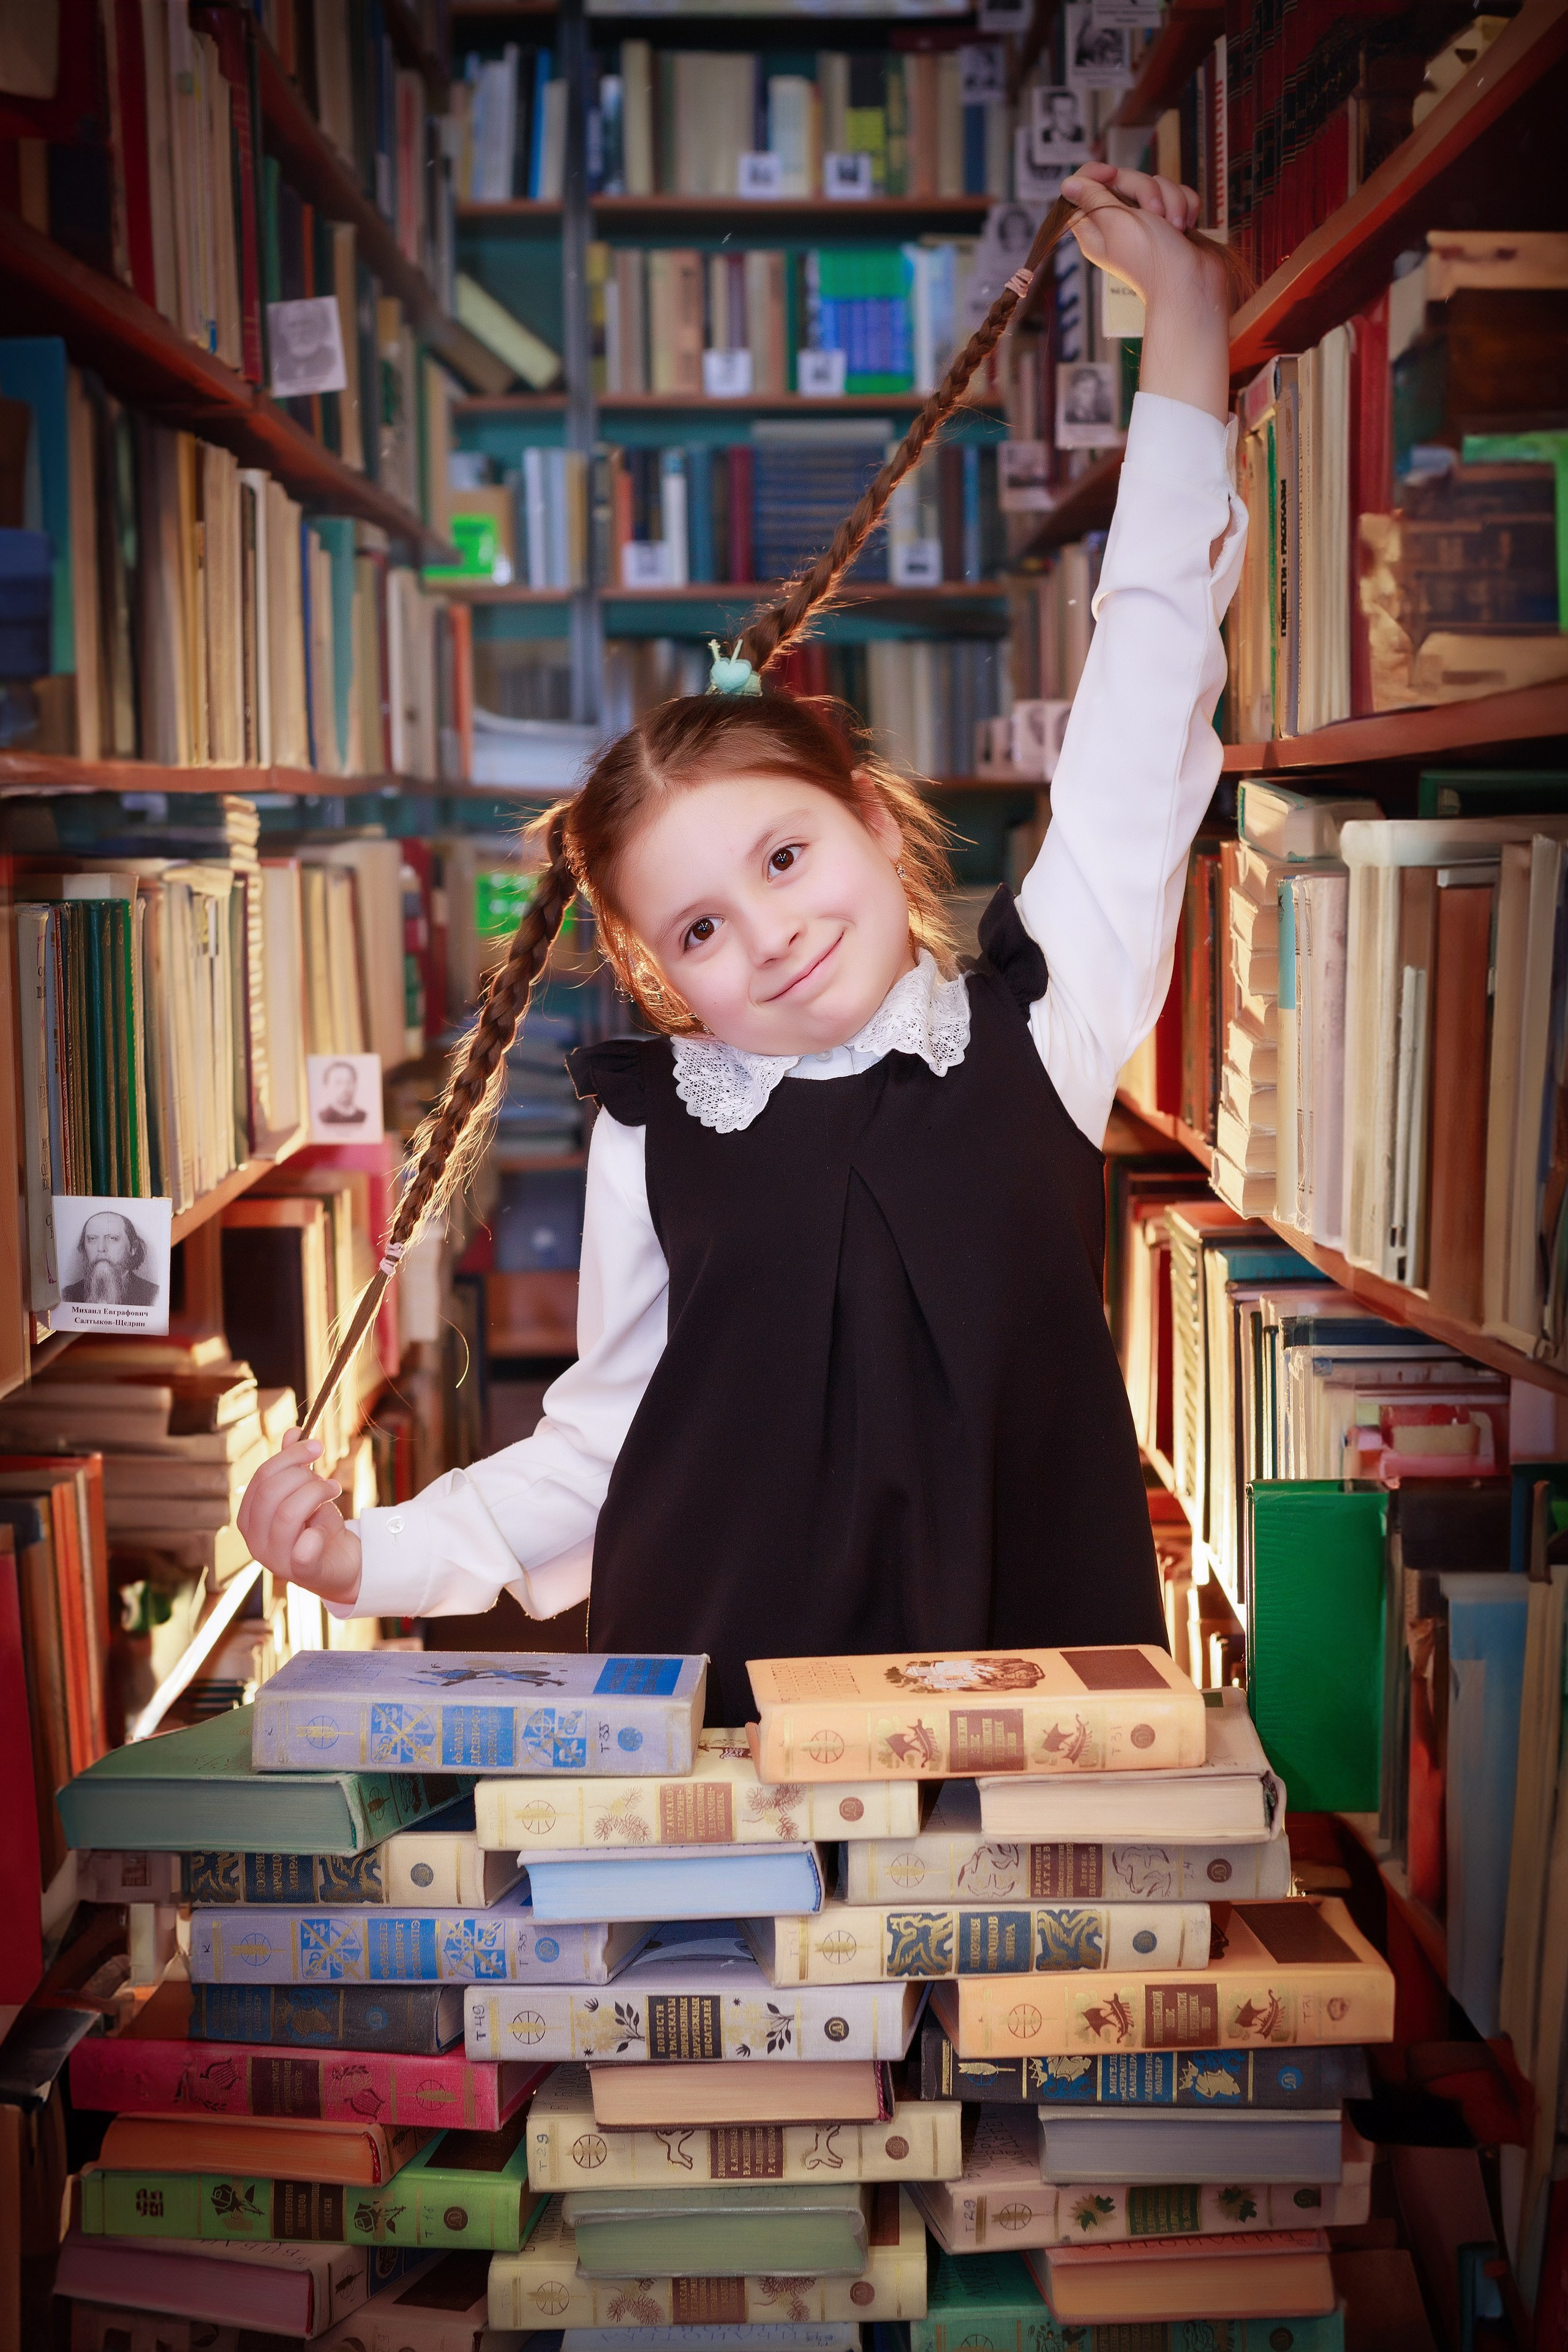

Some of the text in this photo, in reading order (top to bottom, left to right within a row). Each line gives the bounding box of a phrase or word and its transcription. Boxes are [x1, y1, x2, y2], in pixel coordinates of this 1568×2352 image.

[71, 1306, 149, 1317] Михаил Евграфович
[74, 1317, 146, 1327] Салтыков-Щедрин
[273, 1853, 284, 1899] НАРОДО
[289, 1855, 298, 1890] МИРА
[656, 2005, 665, 2052] ПОВЕСТИ
[668, 1998, 677, 2051] РАССКАЗЫ
[680, 1997, 689, 2059] СОВРЕМЕННЫХ
[692, 1997, 701, 2059] ЗАРУБЕЖНЫХ
[701, 1999, 713, 2057] ПИСАТЕЛЕЙ
